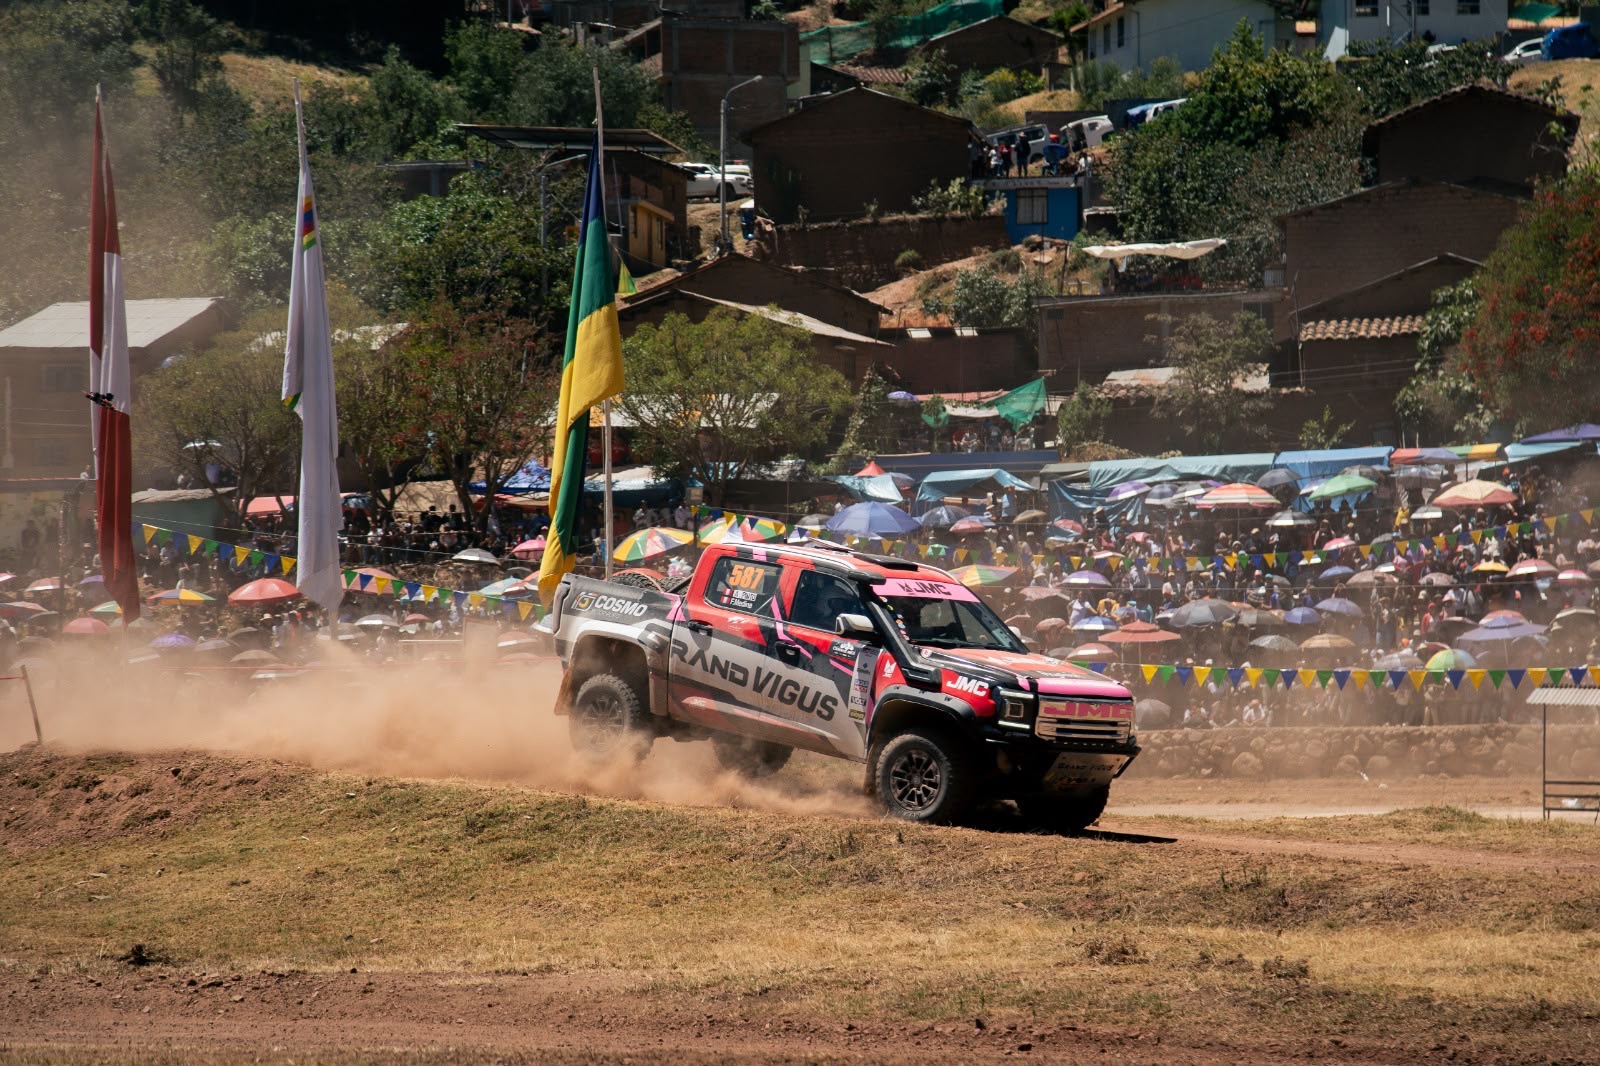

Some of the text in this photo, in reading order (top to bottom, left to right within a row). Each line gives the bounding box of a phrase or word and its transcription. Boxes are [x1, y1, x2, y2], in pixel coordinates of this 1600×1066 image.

[729, 564, 764, 590] 587
[914, 581, 952, 596] JMC
[595, 595, 648, 617] COSMO
[752, 666, 839, 722] VIGUS
[946, 675, 990, 697] JMC
[1043, 701, 1132, 718] JMC
